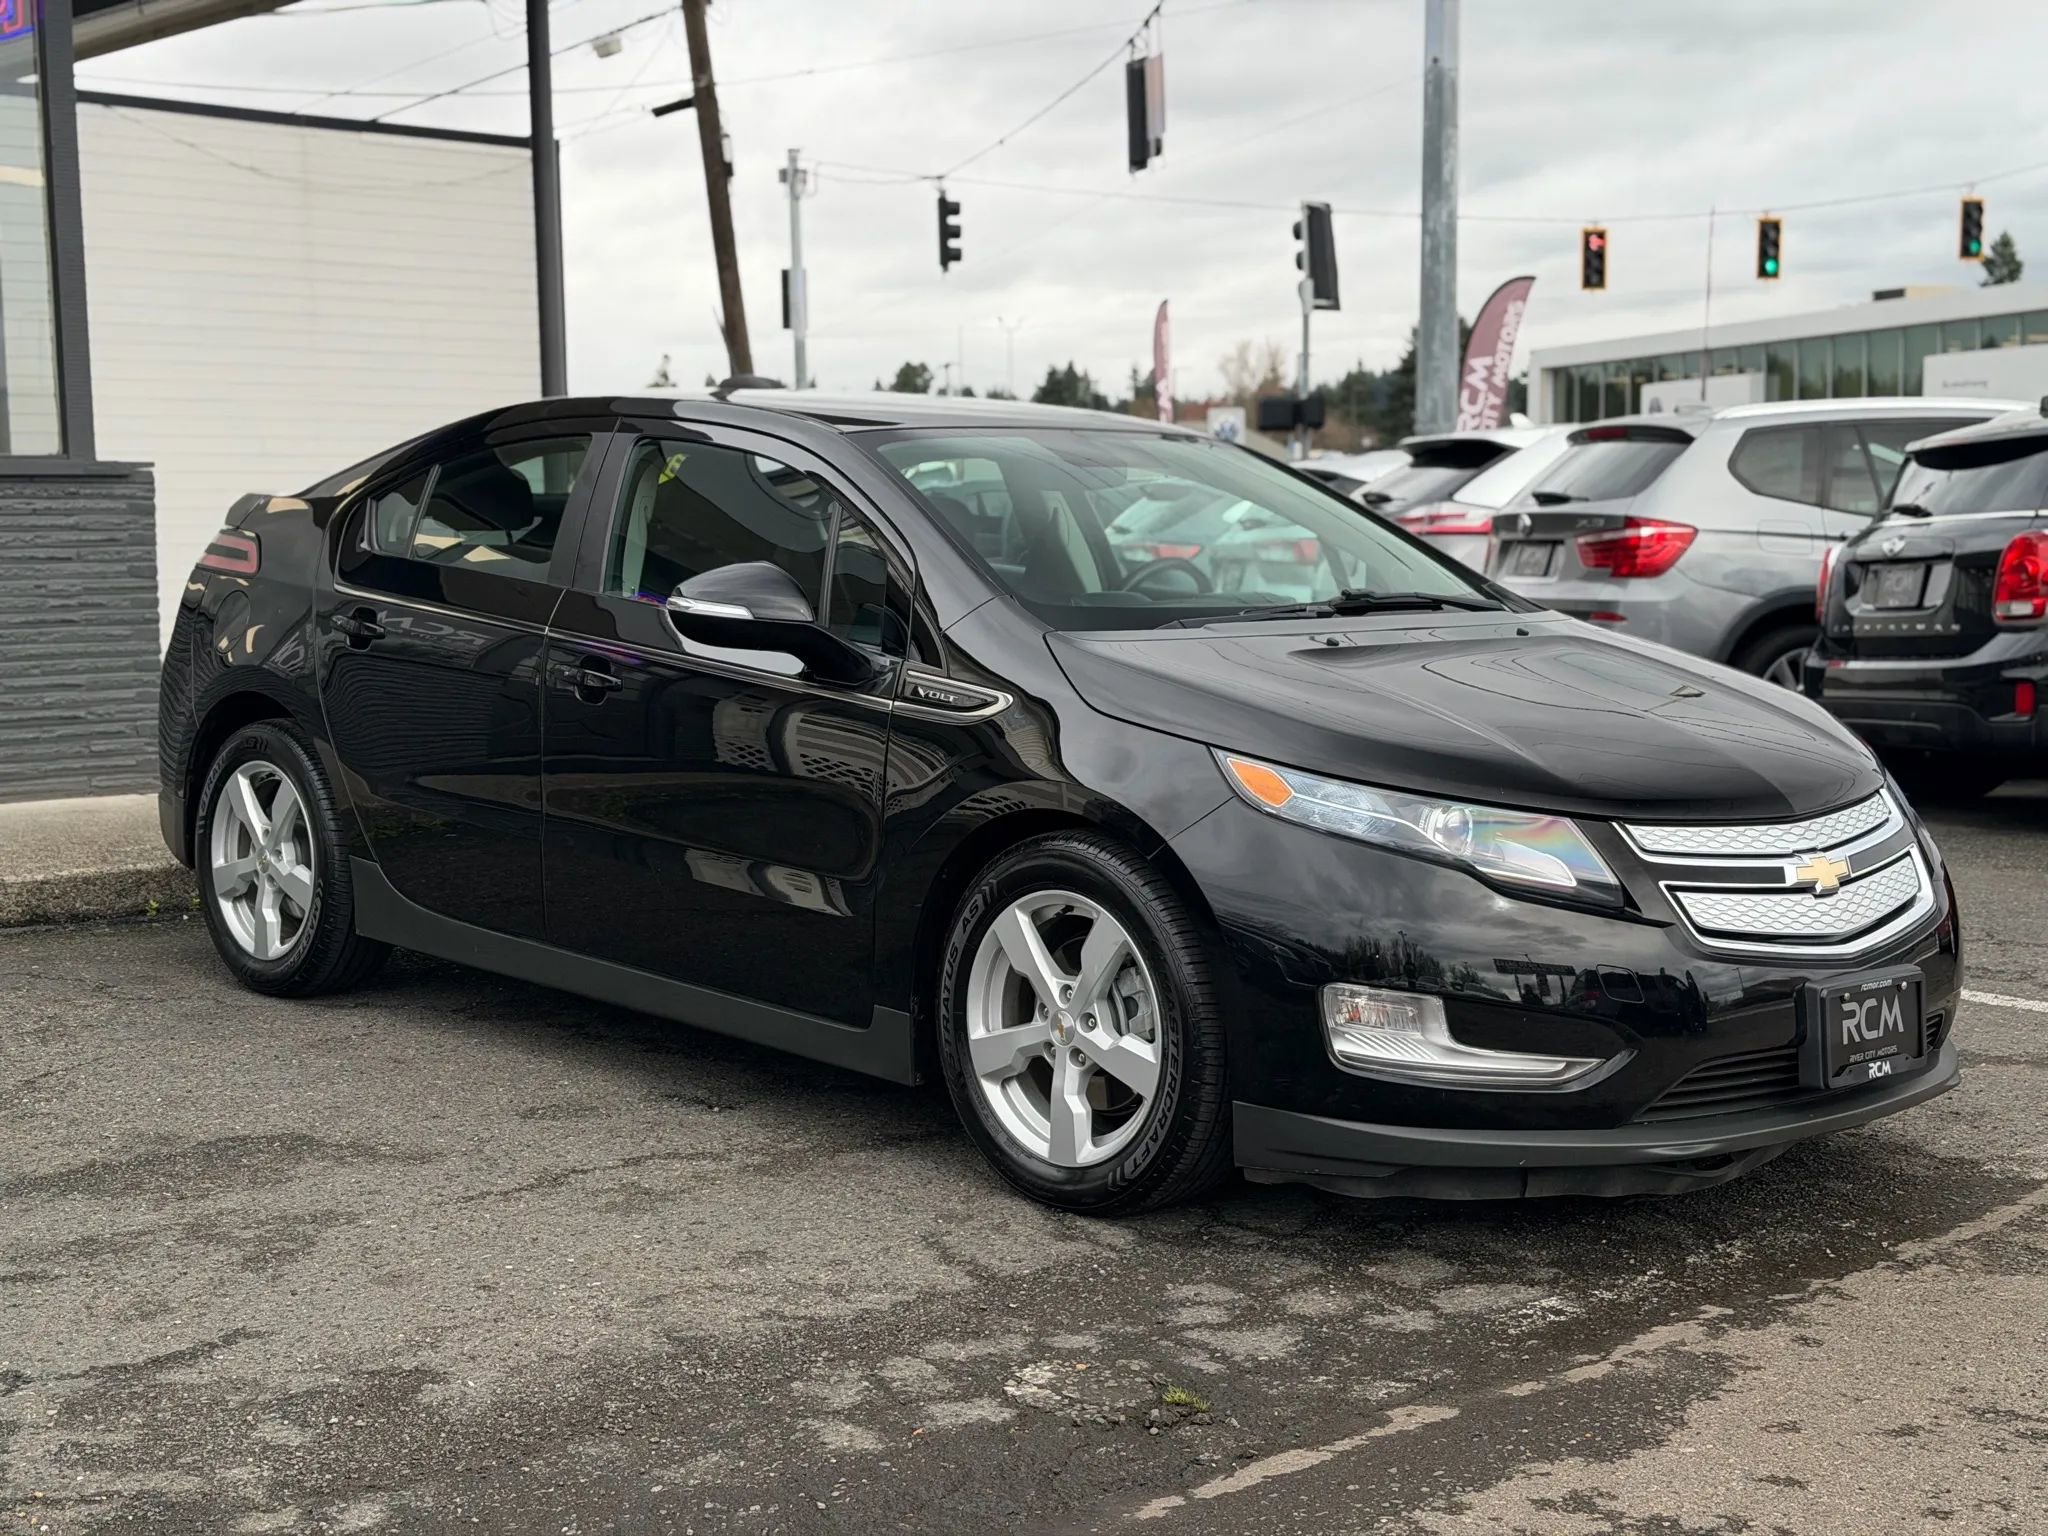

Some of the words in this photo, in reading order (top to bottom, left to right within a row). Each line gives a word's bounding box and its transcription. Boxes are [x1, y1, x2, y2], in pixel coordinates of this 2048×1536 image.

[1492, 300, 1525, 388] MOTORS
[1456, 356, 1494, 431] RCM
[917, 686, 959, 702] VOLT
[941, 942, 960, 1067] STRATUS
[961, 899, 979, 934] AS
[1841, 994, 1904, 1045] RCM
[1129, 971, 1180, 1176] MASTERCRAFT
[1849, 1052, 1864, 1063] RIVER
[1865, 1049, 1876, 1060] CITY
[1877, 1045, 1898, 1056] MOTORS
[1868, 1060, 1892, 1079] RCM
